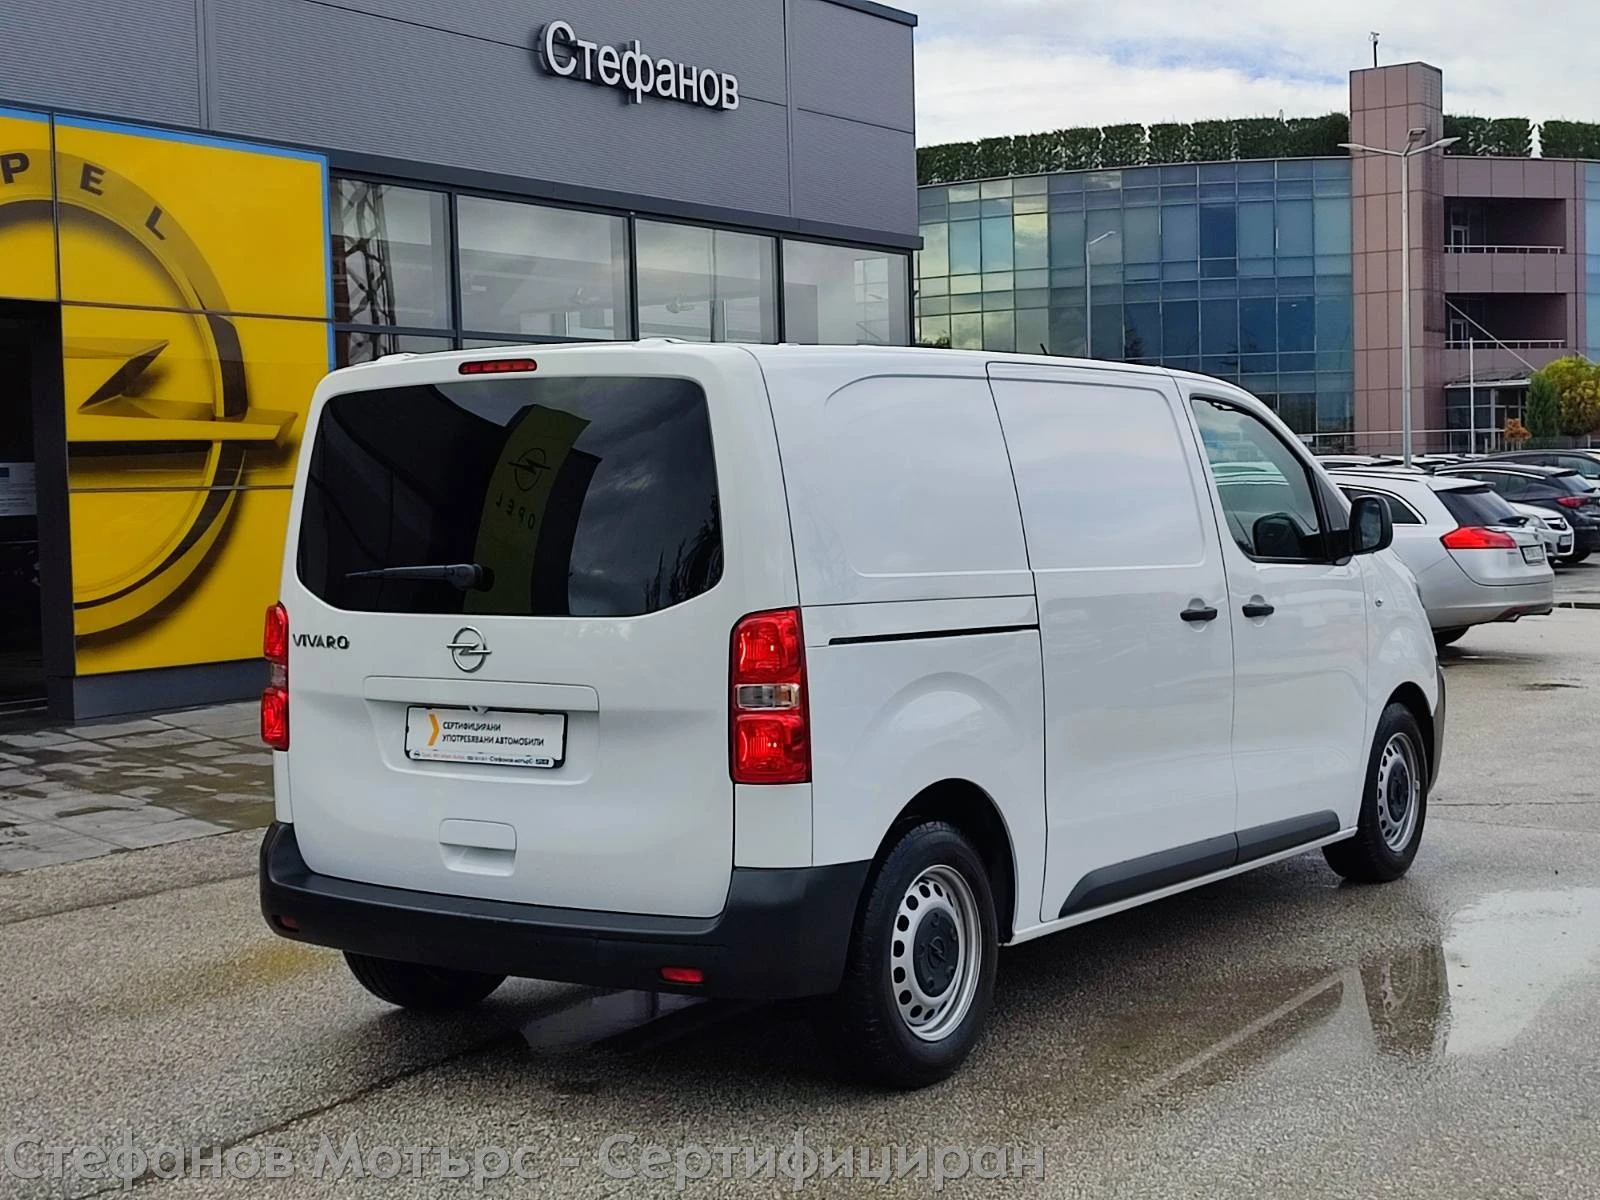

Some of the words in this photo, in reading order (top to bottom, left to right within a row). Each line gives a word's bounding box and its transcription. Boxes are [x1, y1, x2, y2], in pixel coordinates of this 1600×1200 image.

[545, 20, 740, 111] Стефанов
[292, 633, 350, 650] VIVARO
[442, 721, 502, 732] СЕРТИФИЦИРАНИ
[441, 734, 495, 745] УПОТРЕБЯВАНИ
[494, 736, 545, 747] АВТОМОБИЛИ
